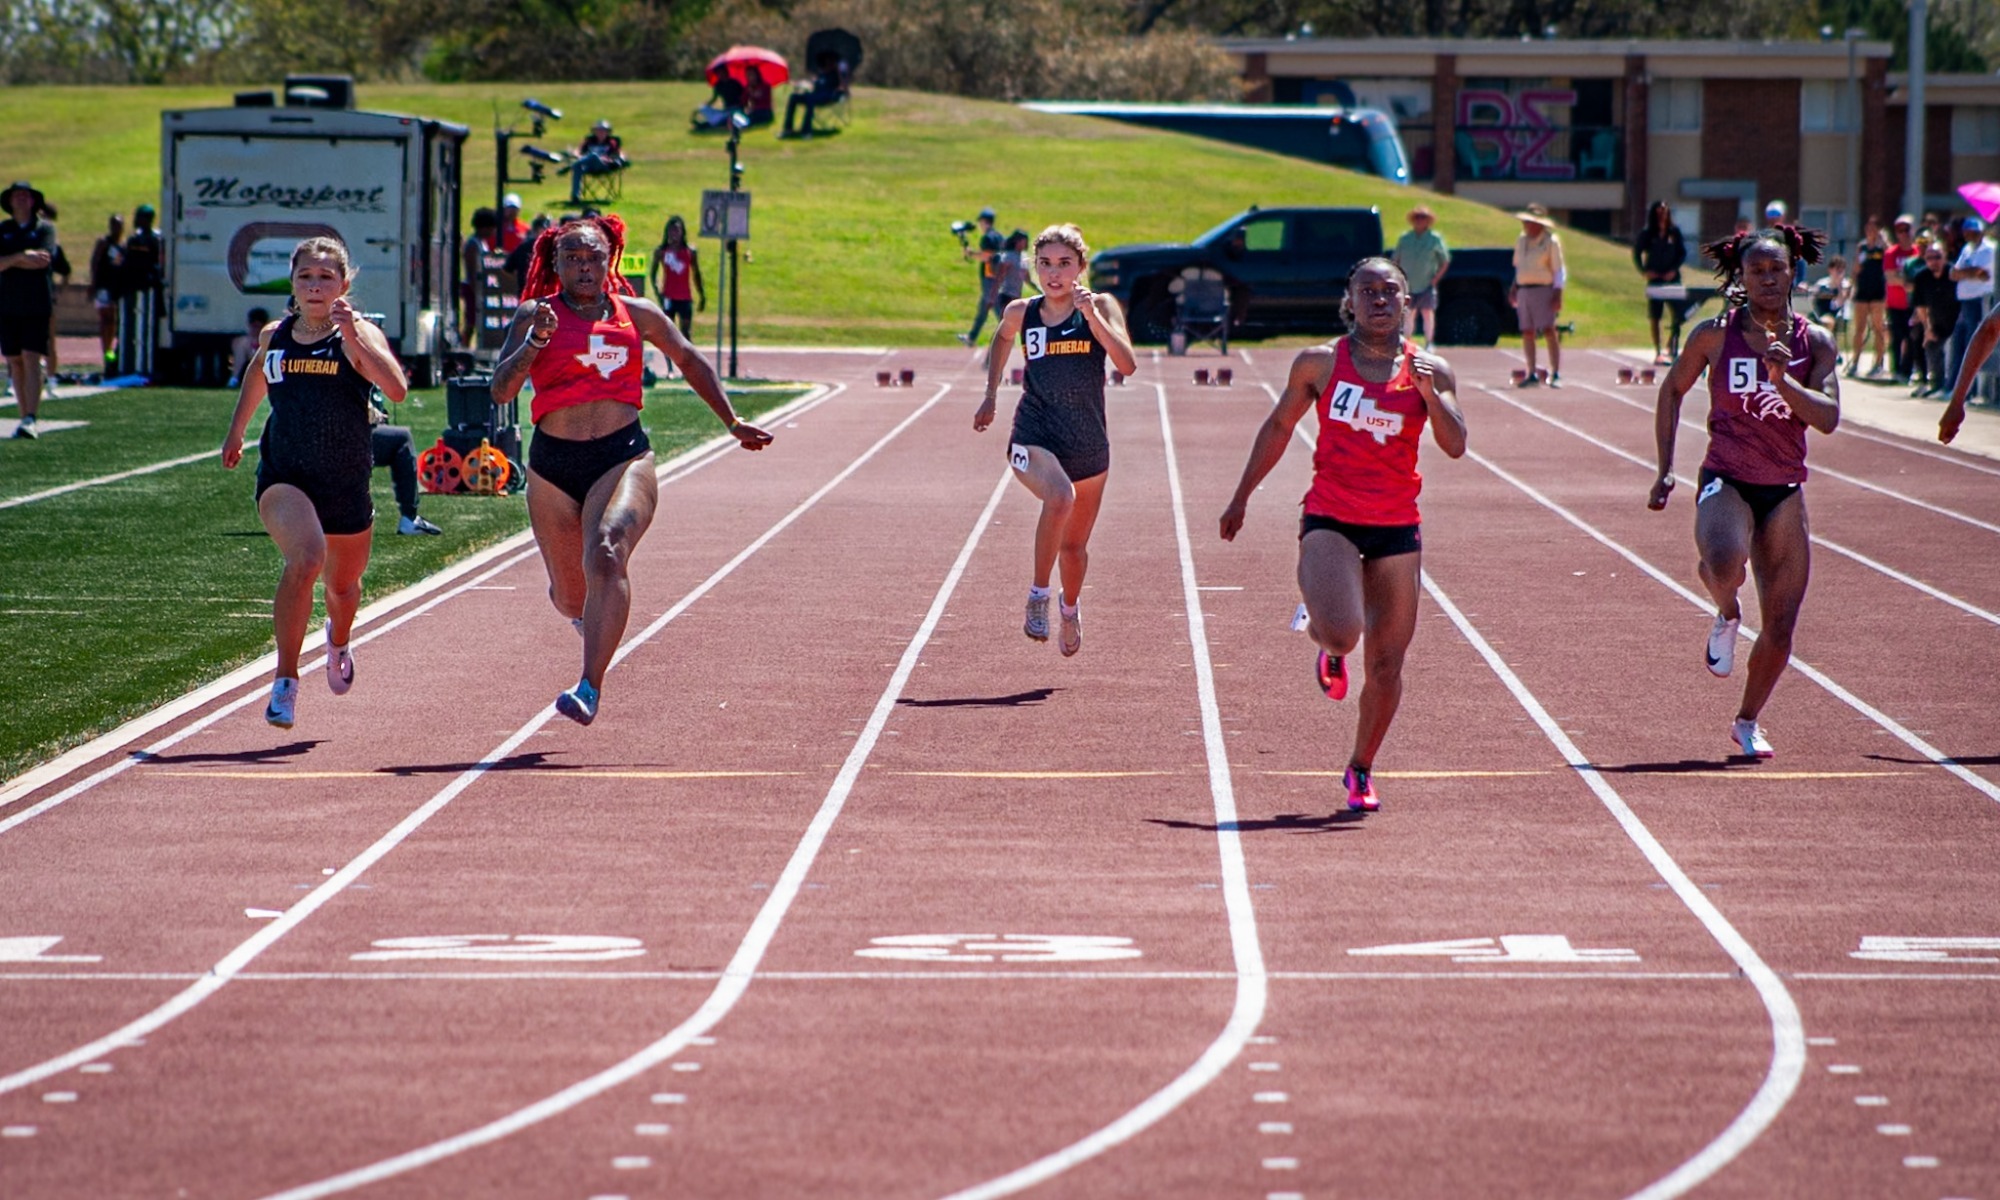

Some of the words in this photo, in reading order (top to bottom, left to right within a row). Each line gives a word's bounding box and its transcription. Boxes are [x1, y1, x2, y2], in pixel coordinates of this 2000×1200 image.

[194, 176, 384, 204] Motorsport
[596, 351, 620, 360] UST
[1028, 330, 1040, 356] 3
[1046, 340, 1092, 355] LUTHERAN
[266, 352, 276, 380] 1
[288, 359, 340, 375] LUTHERAN
[1733, 361, 1749, 389] 5
[1332, 387, 1353, 417] 4
[1366, 416, 1395, 428] UST
[1013, 452, 1027, 470] 3
[348, 933, 648, 962] 2
[853, 933, 1143, 963] 3
[1347, 934, 1643, 963] 4
